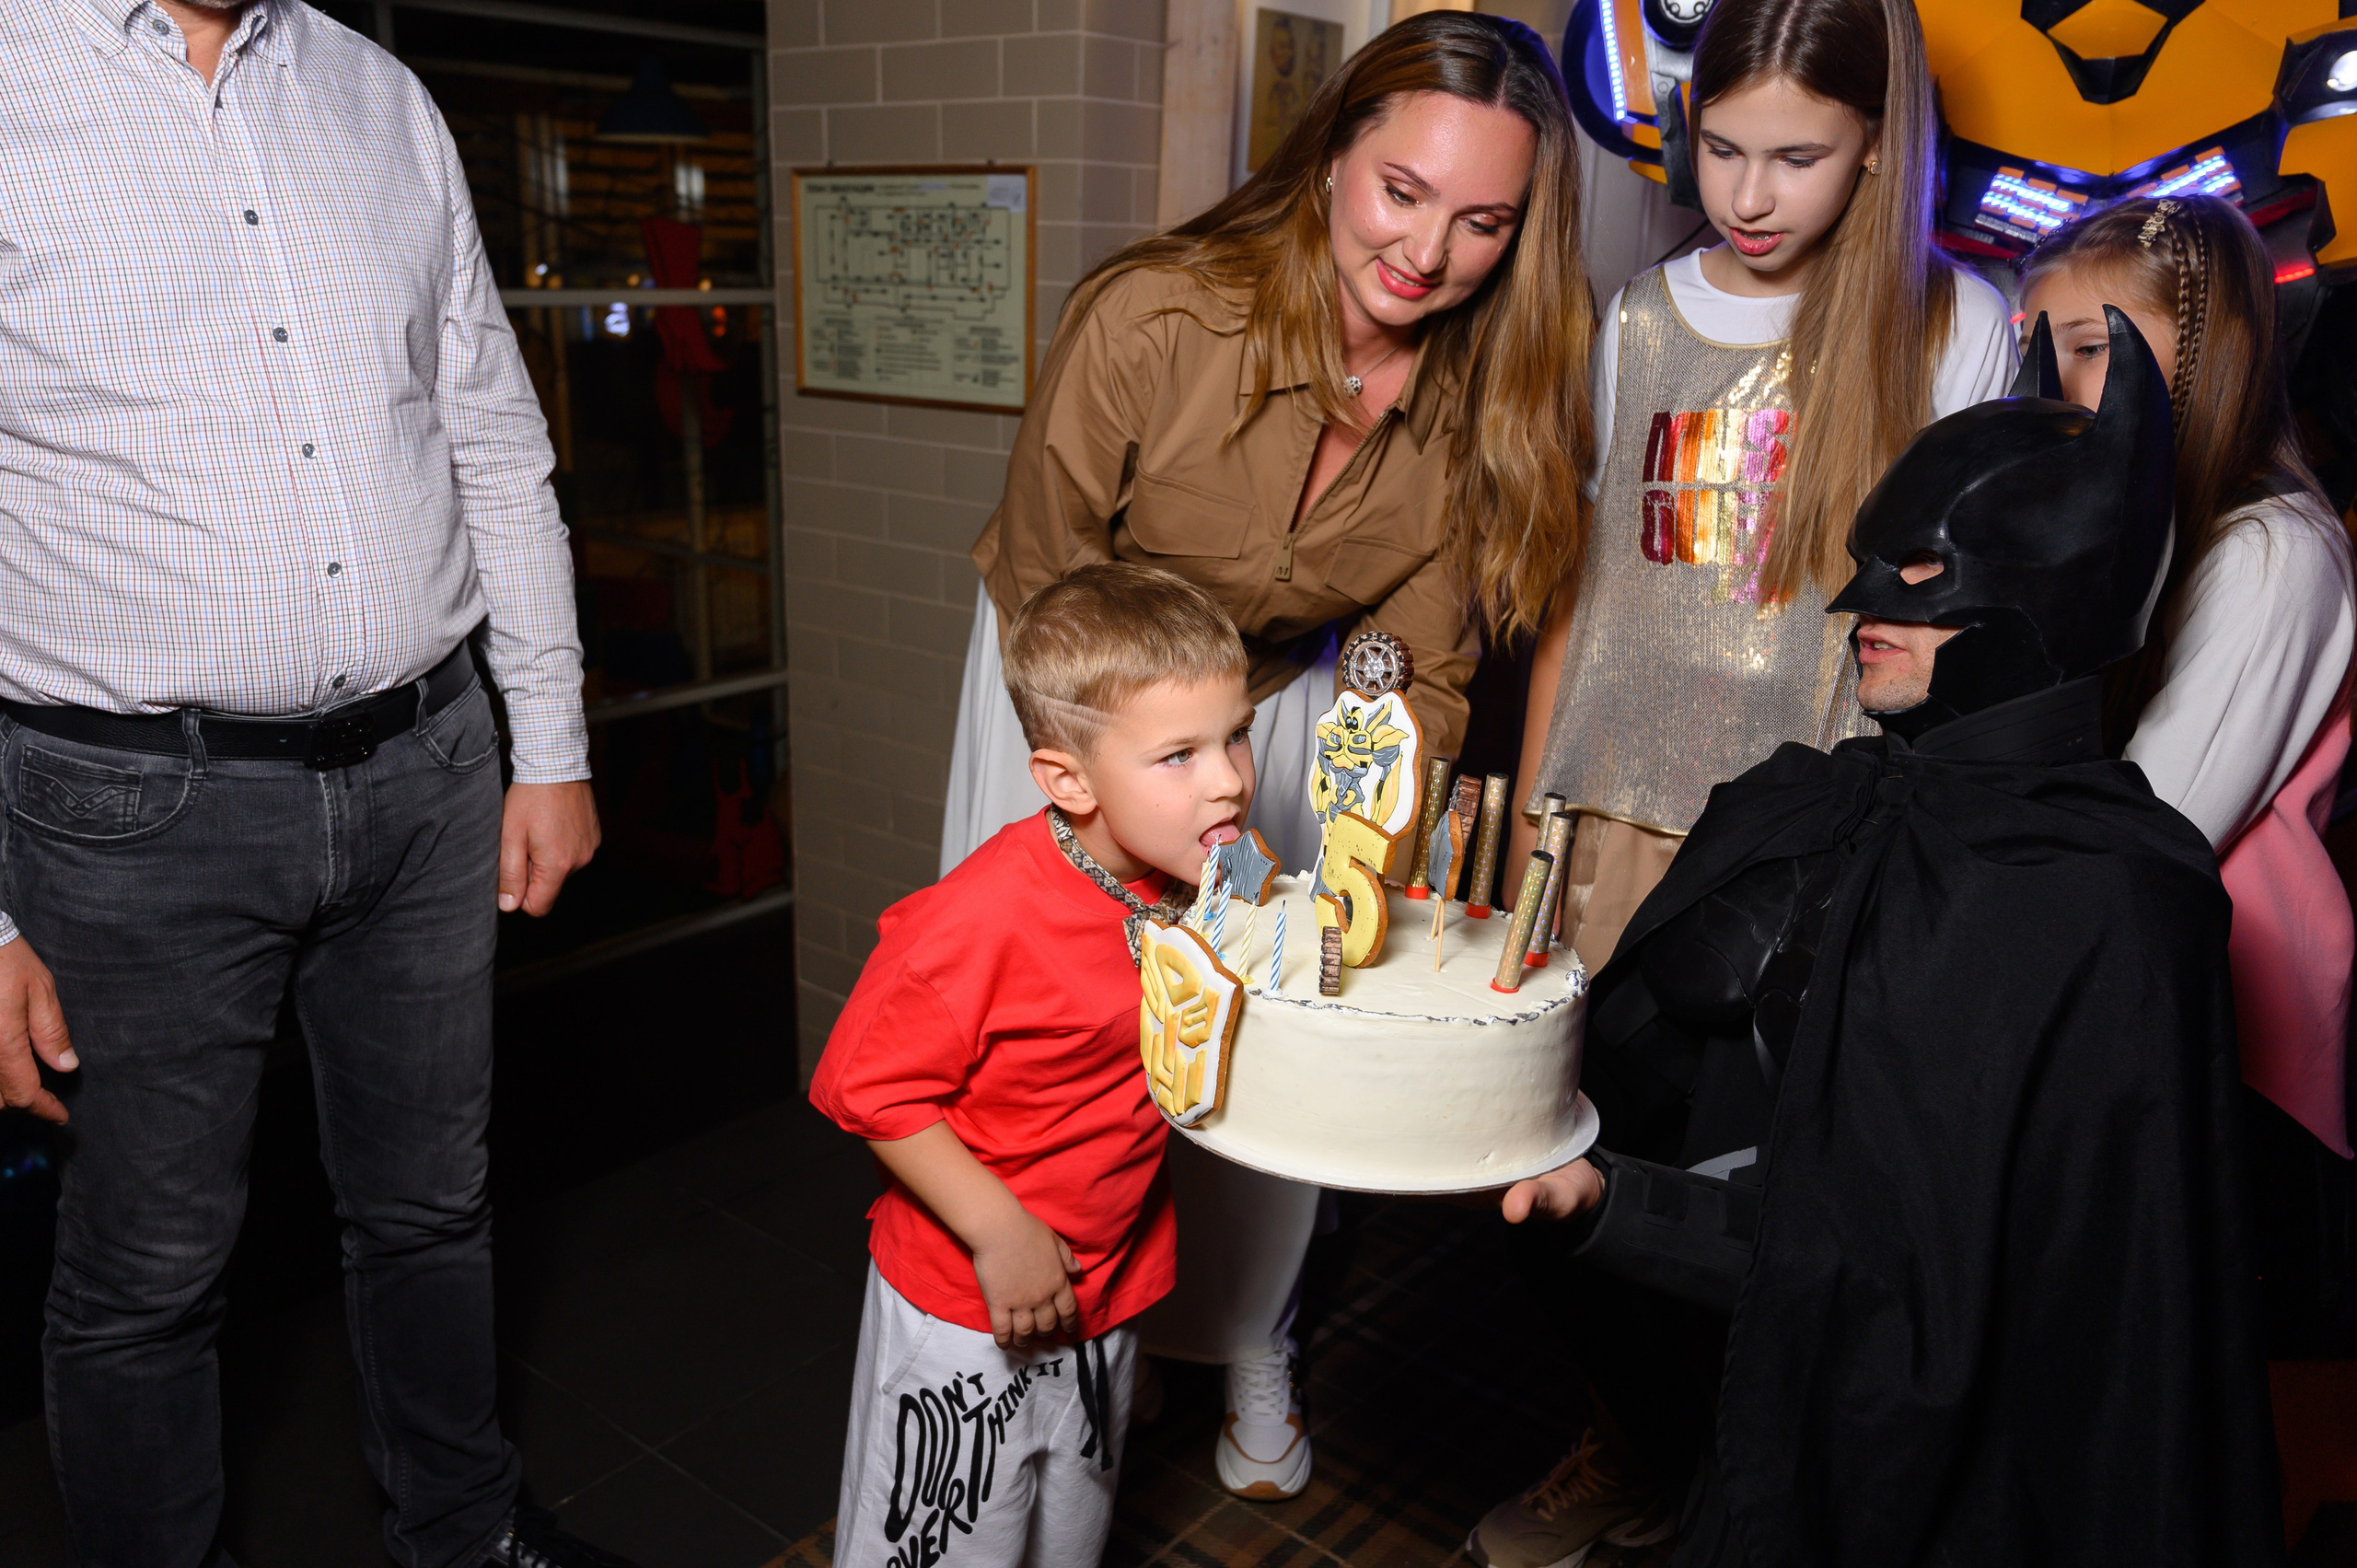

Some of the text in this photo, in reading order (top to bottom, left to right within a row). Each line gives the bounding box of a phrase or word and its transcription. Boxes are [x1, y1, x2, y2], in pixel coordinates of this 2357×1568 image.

[1643, 409, 1798, 483] MUS
[1316, 811, 1397, 969] 5
[1037, 1358, 1063, 1377] IT
[885, 1371, 984, 1543] DON'T
